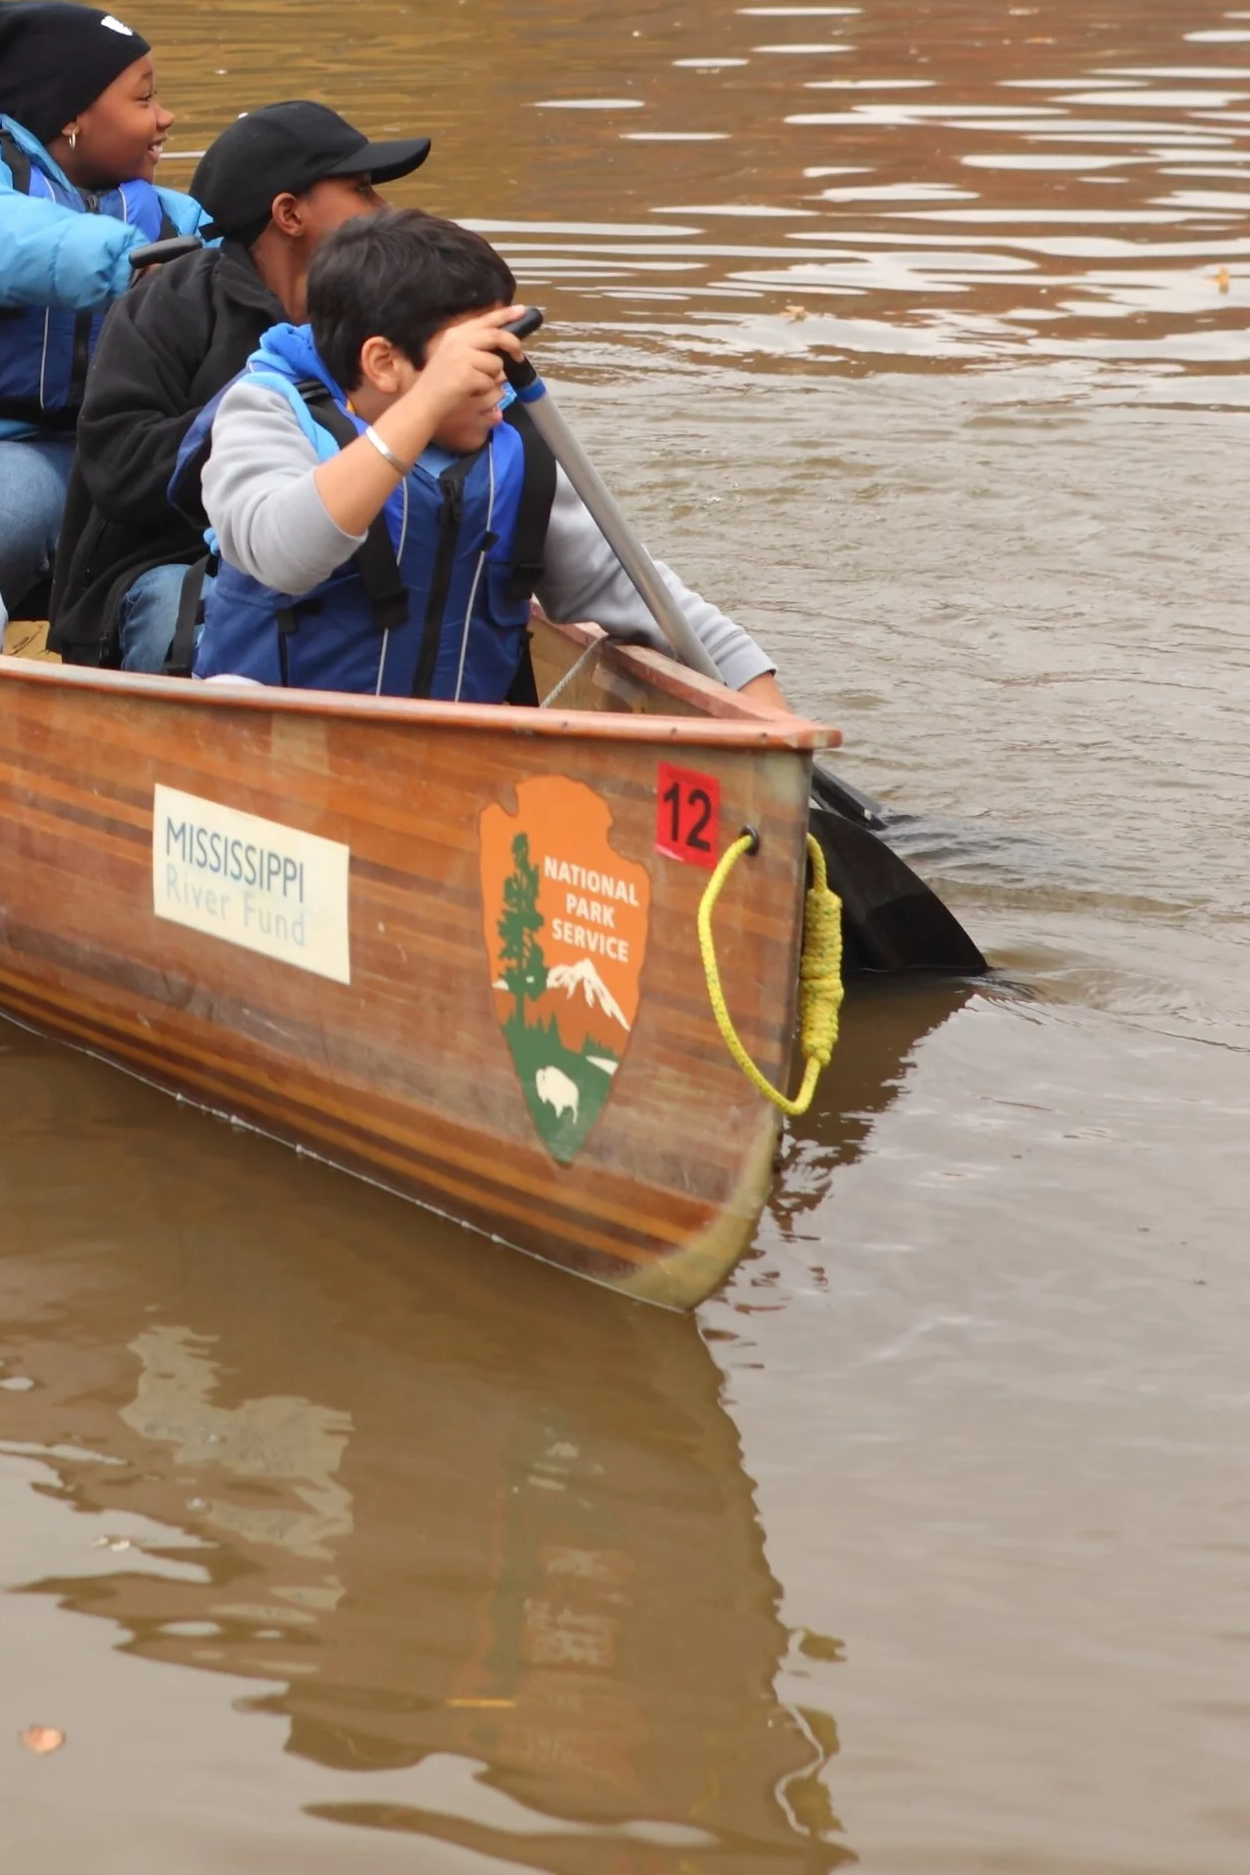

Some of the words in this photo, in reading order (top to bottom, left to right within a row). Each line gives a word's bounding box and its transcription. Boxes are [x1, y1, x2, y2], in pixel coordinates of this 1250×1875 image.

[662, 781, 711, 852] 12
[166, 817, 304, 903] MISSISSIPPI
[544, 856, 639, 906] NATIONAL
[166, 863, 230, 921] River
[243, 891, 306, 947] Fund
[566, 893, 615, 928] PARK
[552, 918, 629, 963] SERVICE
